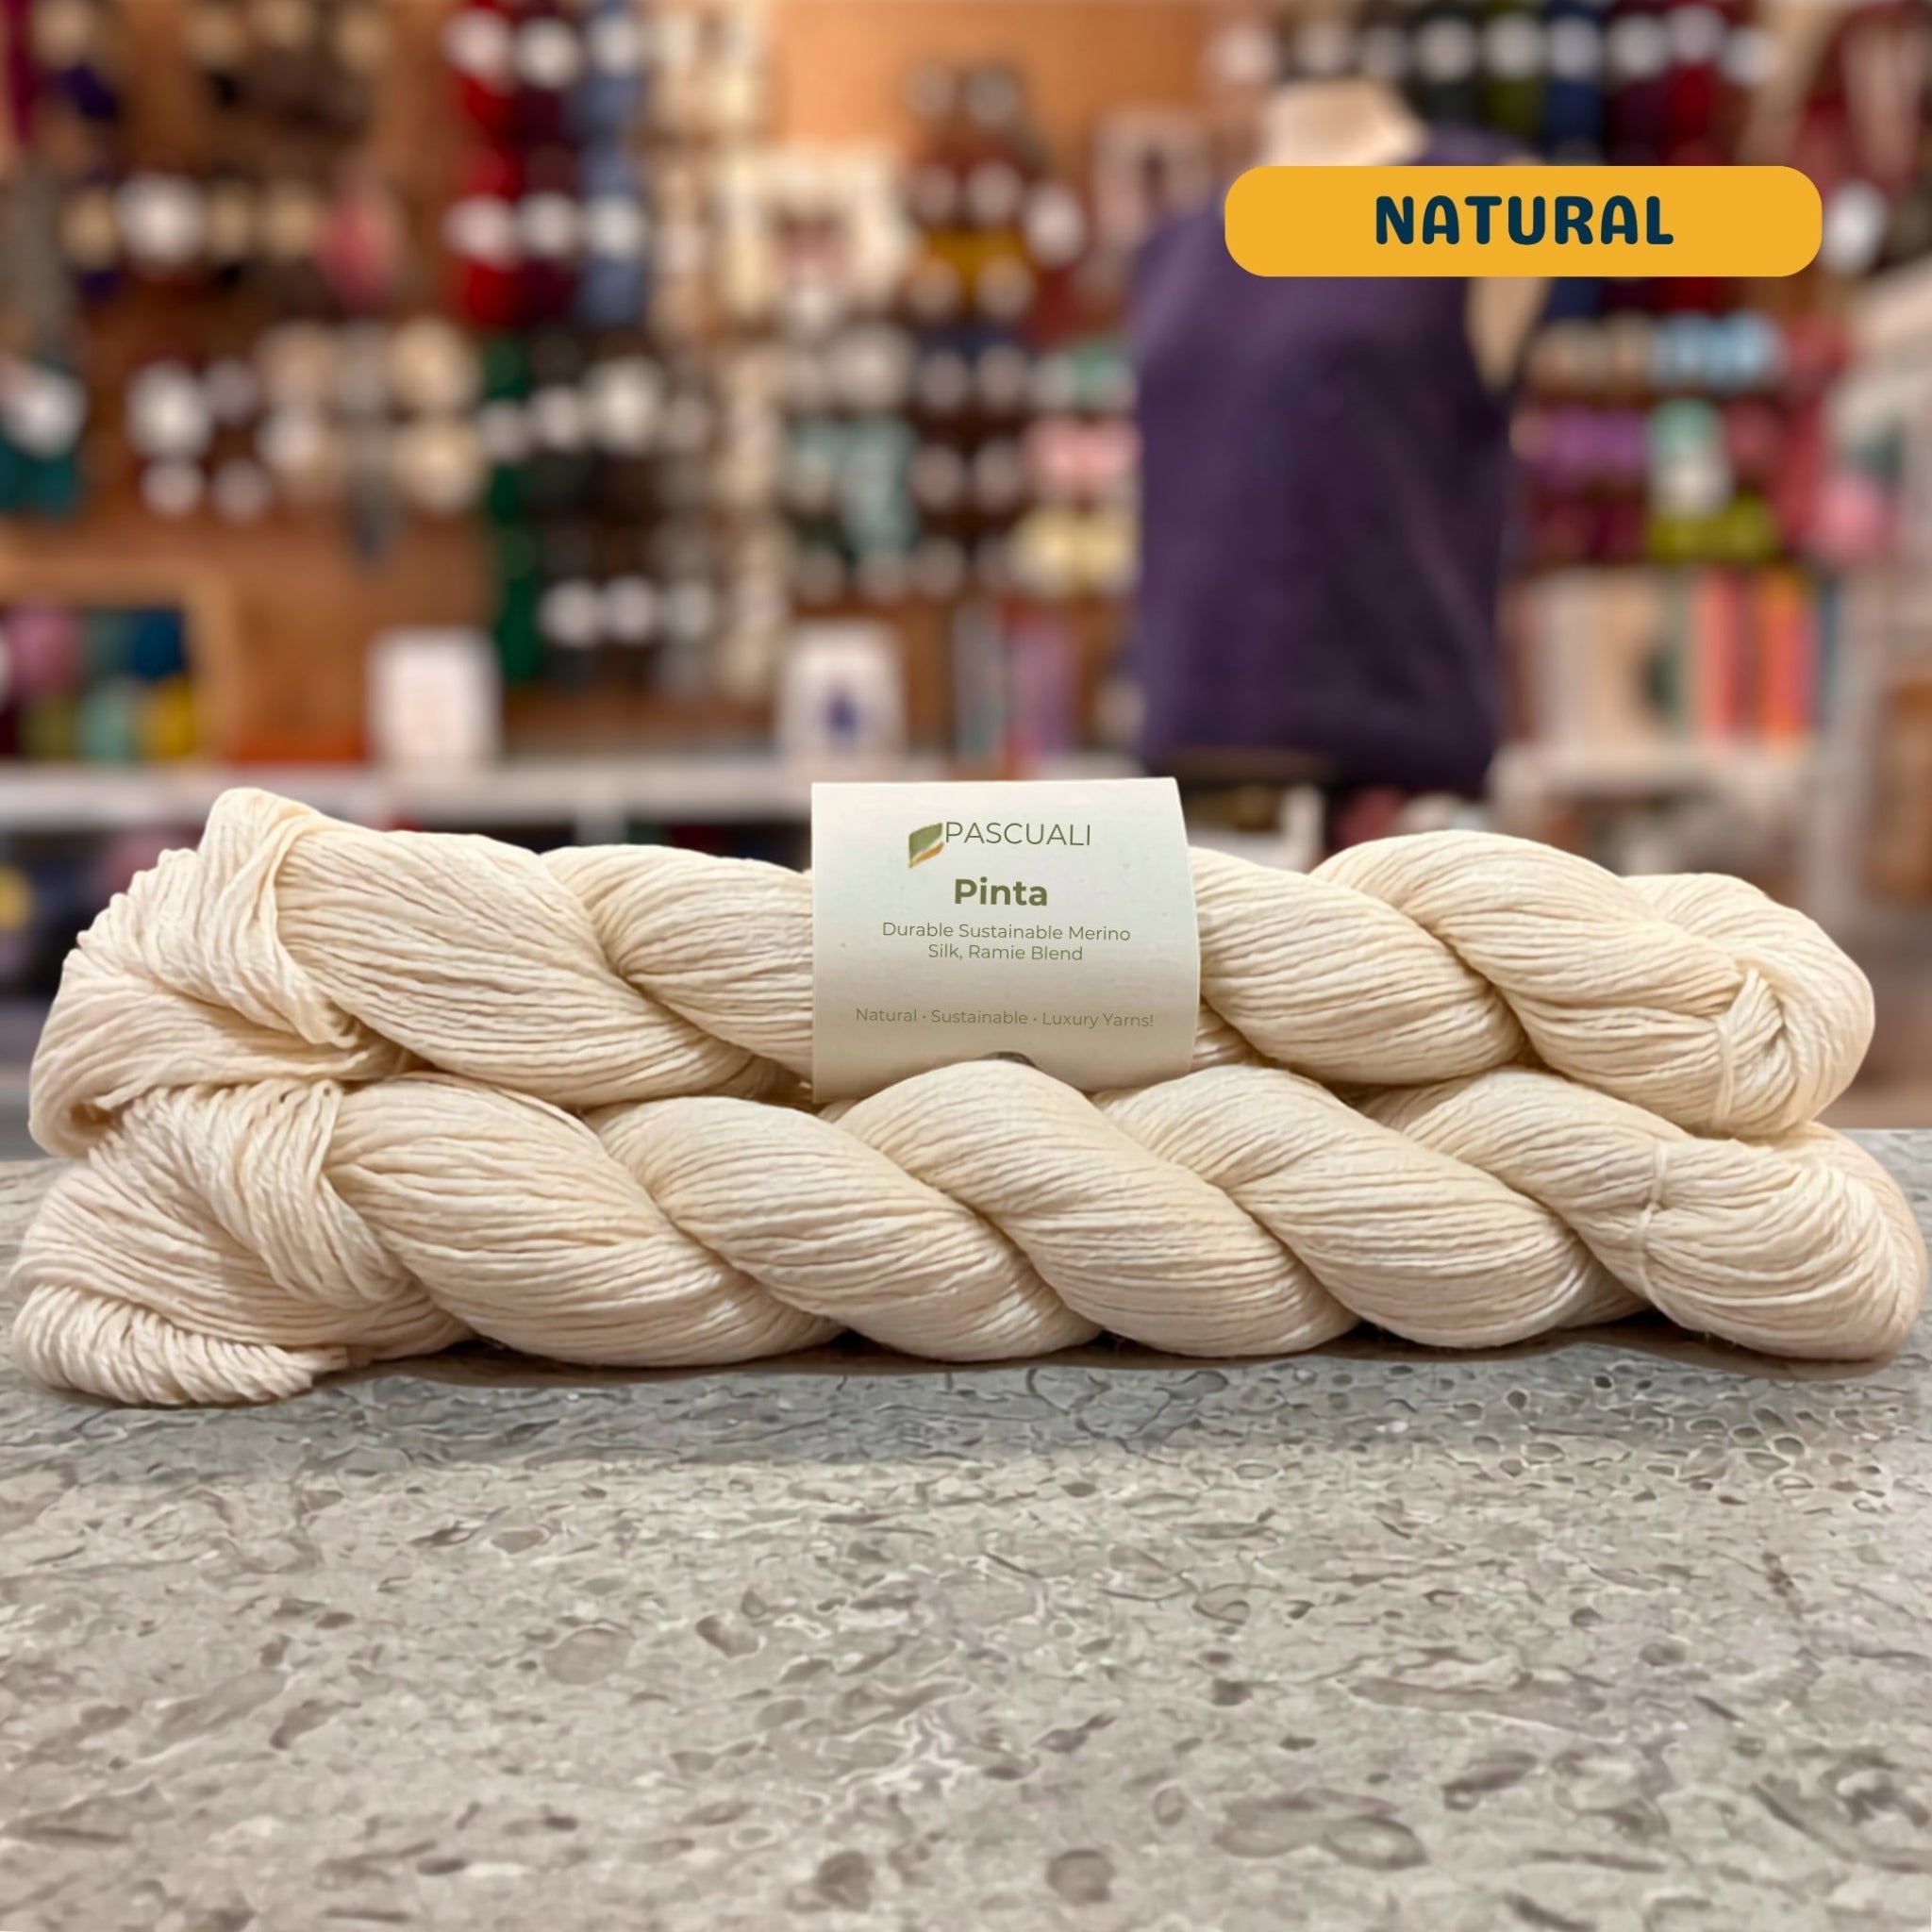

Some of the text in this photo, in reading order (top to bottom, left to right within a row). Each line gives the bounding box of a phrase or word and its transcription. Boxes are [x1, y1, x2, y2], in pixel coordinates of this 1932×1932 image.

[945, 821, 1091, 846] PASCUALI
[954, 876, 1048, 907] Pinta
[882, 922, 1131, 941] Durable Sustainable Merino
[927, 943, 1083, 961] Silk, Ramie Blend
[856, 1008, 1154, 1029] Natural Sustainable Luxury Yarns!
